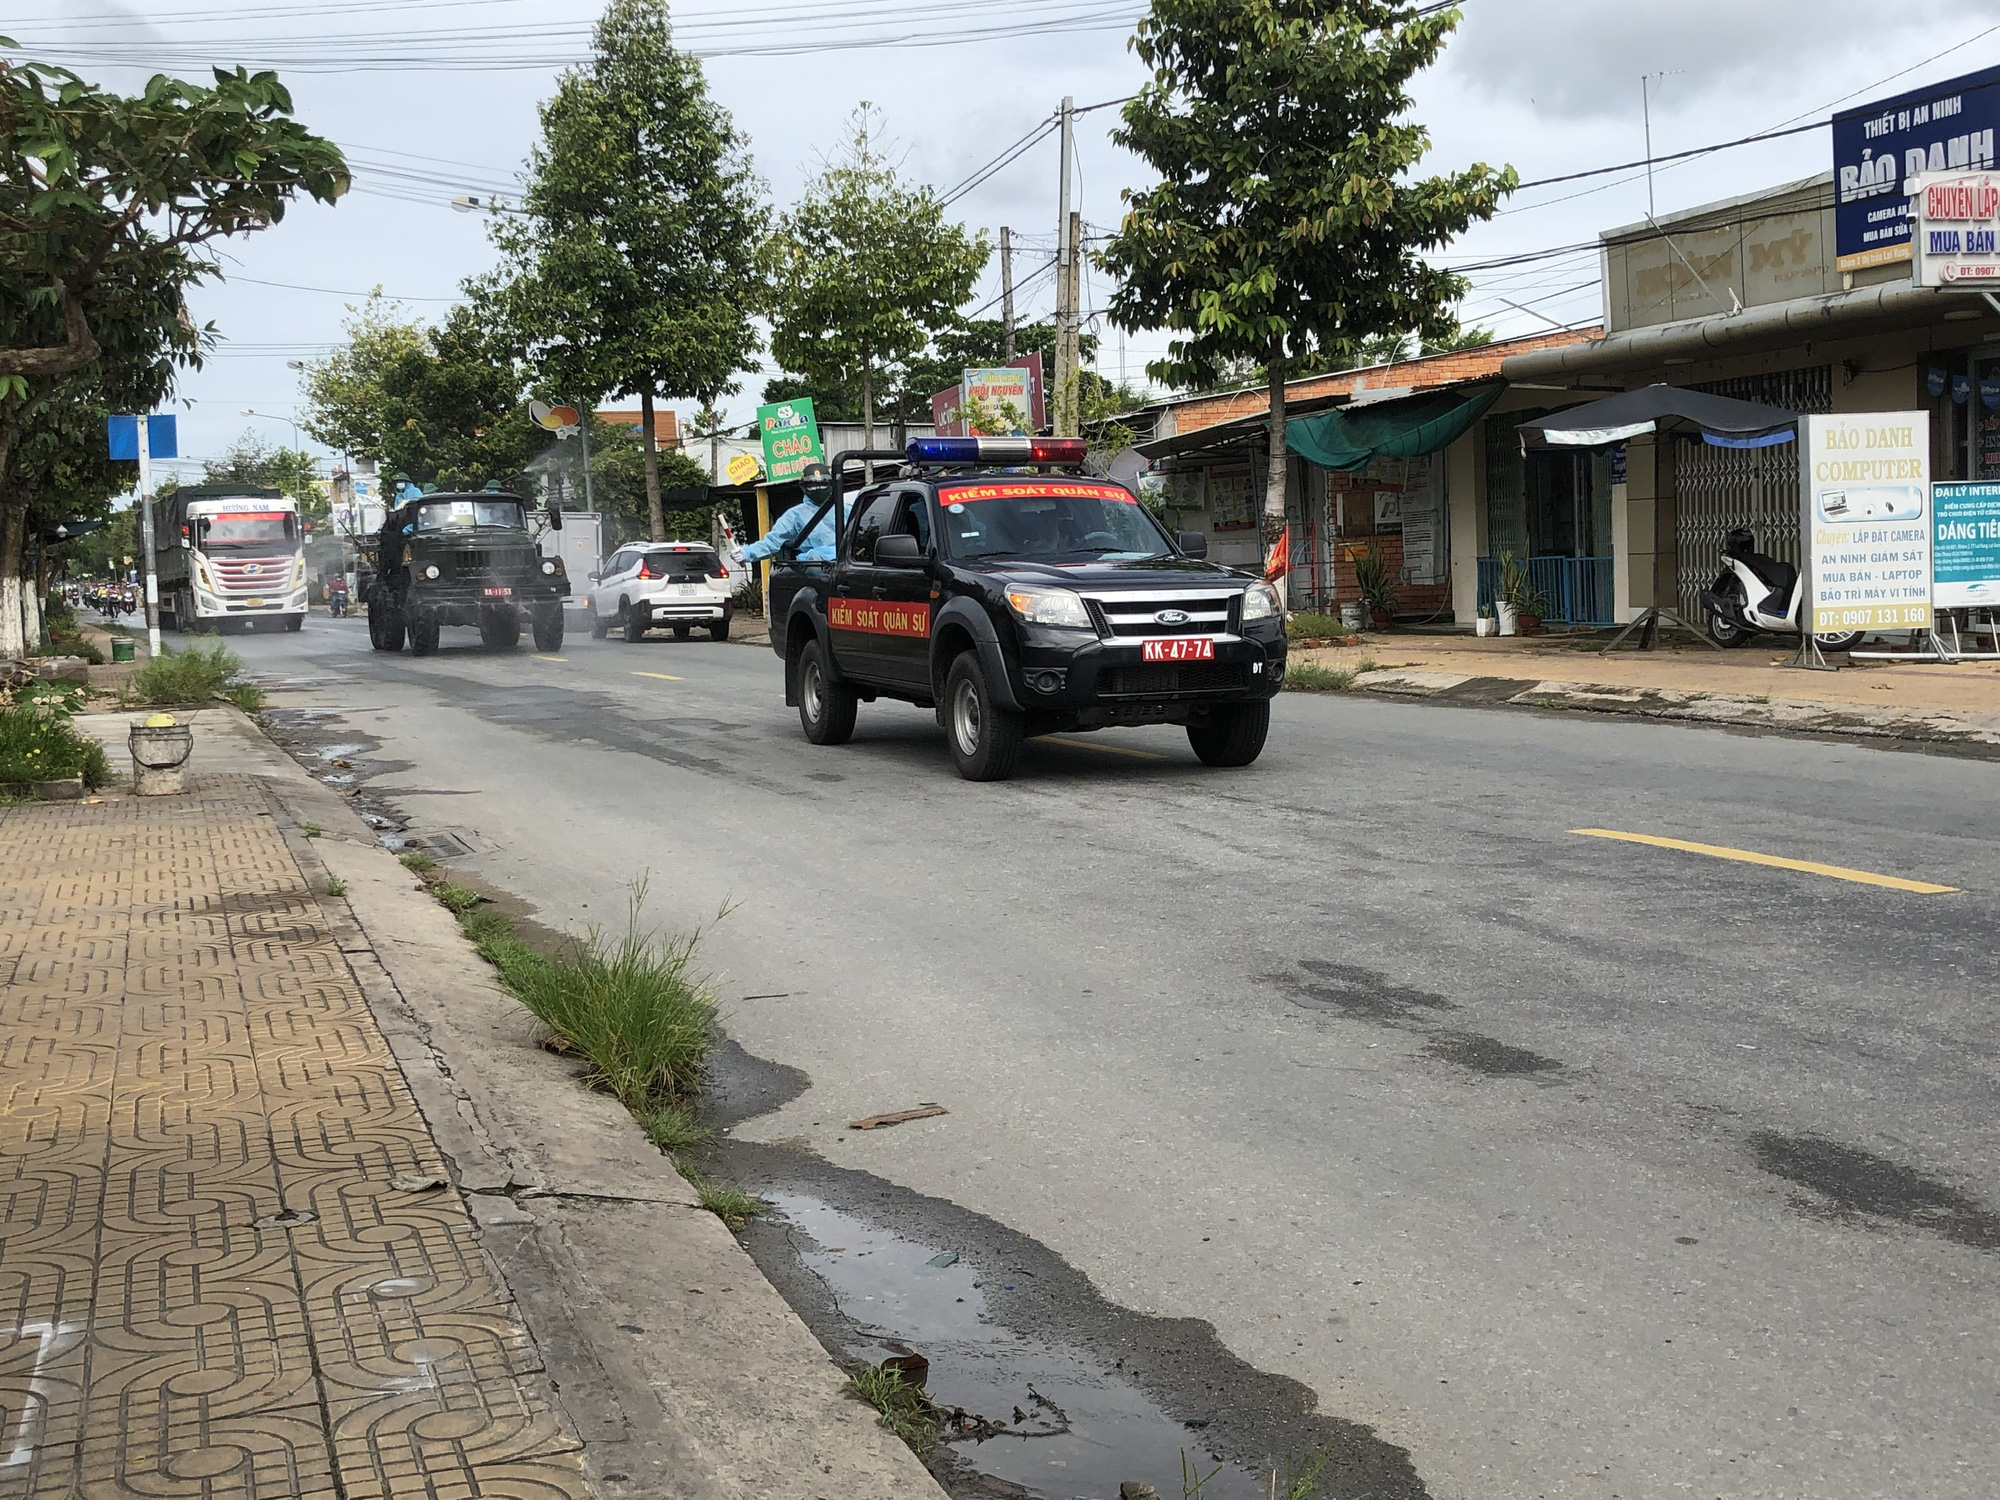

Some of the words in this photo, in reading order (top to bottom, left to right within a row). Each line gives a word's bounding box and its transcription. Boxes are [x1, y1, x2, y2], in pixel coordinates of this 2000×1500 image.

[1863, 110, 1896, 139] THIẾT
[1898, 109, 1910, 132] BỊ
[1913, 104, 1929, 126] AN
[1932, 95, 1961, 120] NINH
[1839, 148, 1897, 203] BẢO
[1928, 180, 1973, 218] CHUYÊN
[1978, 175, 1998, 218] LẮP
[1867, 207, 1896, 223] CAMERA
[1863, 230, 1878, 242] MUA
[1879, 225, 1893, 239] BÁN
[1894, 222, 1908, 236] SỬA
[1930, 231, 1961, 253] MUA
[1967, 226, 1994, 252] BÁN
[1975, 266, 1995, 275] 0907
[1825, 421, 1860, 450] BẢO
[1865, 427, 1913, 449] DANH
[1815, 458, 1923, 482] COMPUTER
[948, 487, 996, 501] KIỂM
[1002, 485, 1047, 496] SOÁT
[1052, 486, 1100, 497] QUÂN
[1104, 490, 1127, 501] SỰ
[1935, 487, 1953, 500] ĐẠI
[1955, 485, 1967, 496] LÝ
[1853, 528, 1869, 544] LẮP
[1872, 530, 1890, 547] ĐẶT
[1892, 529, 1925, 544] CAMERA
[1938, 520, 1976, 541] DÁNG
[1821, 554, 1836, 565] AN
[1840, 553, 1867, 564] NINH
[1871, 551, 1899, 563] GIÁM
[1902, 551, 1924, 562] SÁT
[1823, 573, 1846, 583] MUA
[1850, 568, 1871, 582] BÁN
[1882, 570, 1922, 581] LAPTOP
[1820, 587, 1841, 601] BẢO
[1844, 586, 1861, 600] TRÌ
[1865, 587, 1887, 599] MÁY
[1890, 588, 1899, 598] VI
[1903, 587, 1926, 597] TÍNH
[831, 600, 852, 626] KIỂM
[856, 606, 879, 628] SOÁT
[883, 608, 908, 632] QUÂN
[912, 611, 926, 637] SỰ
[1162, 612, 1183, 622] Ford
[1819, 611, 1839, 626] ĐT:
[1843, 609, 1871, 625] 0907
[1877, 609, 1898, 623] 131
[1904, 607, 1925, 622] 160
[1144, 640, 1212, 660] KK-47-74
